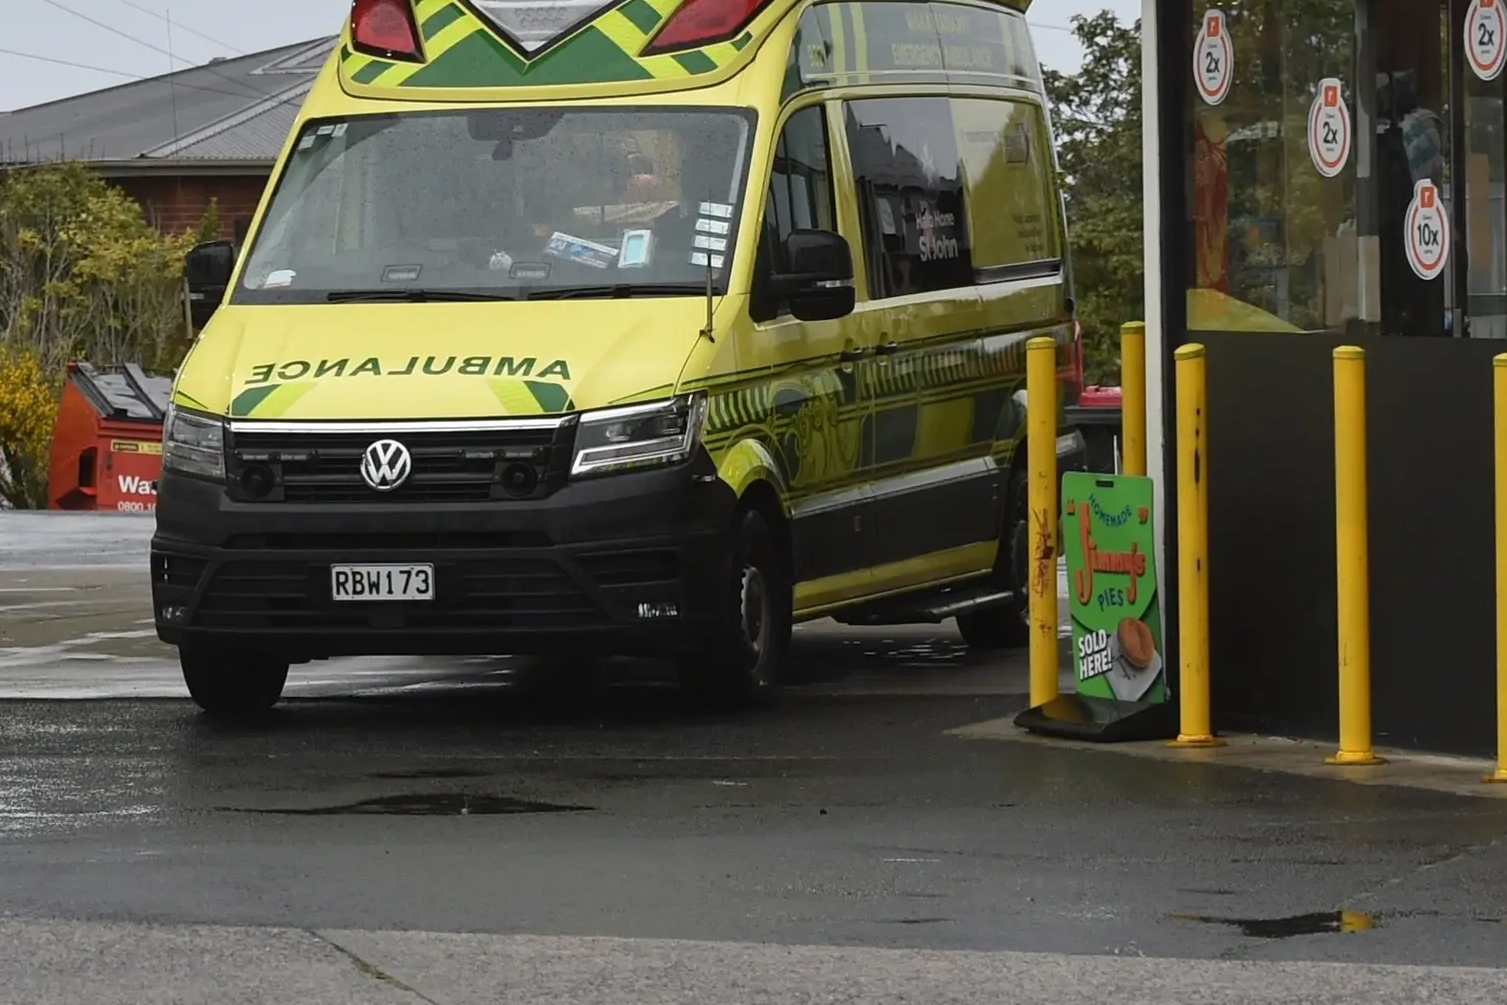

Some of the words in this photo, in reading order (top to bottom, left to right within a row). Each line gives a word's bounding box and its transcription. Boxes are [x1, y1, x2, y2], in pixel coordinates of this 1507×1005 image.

[1478, 23, 1495, 46] 2x
[1205, 51, 1221, 74] 2x
[1322, 121, 1338, 145] 2x
[1417, 222, 1439, 247] 10x
[1089, 493, 1133, 528] HOMEMADE
[335, 570, 430, 596] RBW173
[1097, 587, 1125, 612] PIES
[1077, 628, 1108, 658] SOLD
[1078, 651, 1113, 682] HERE!
